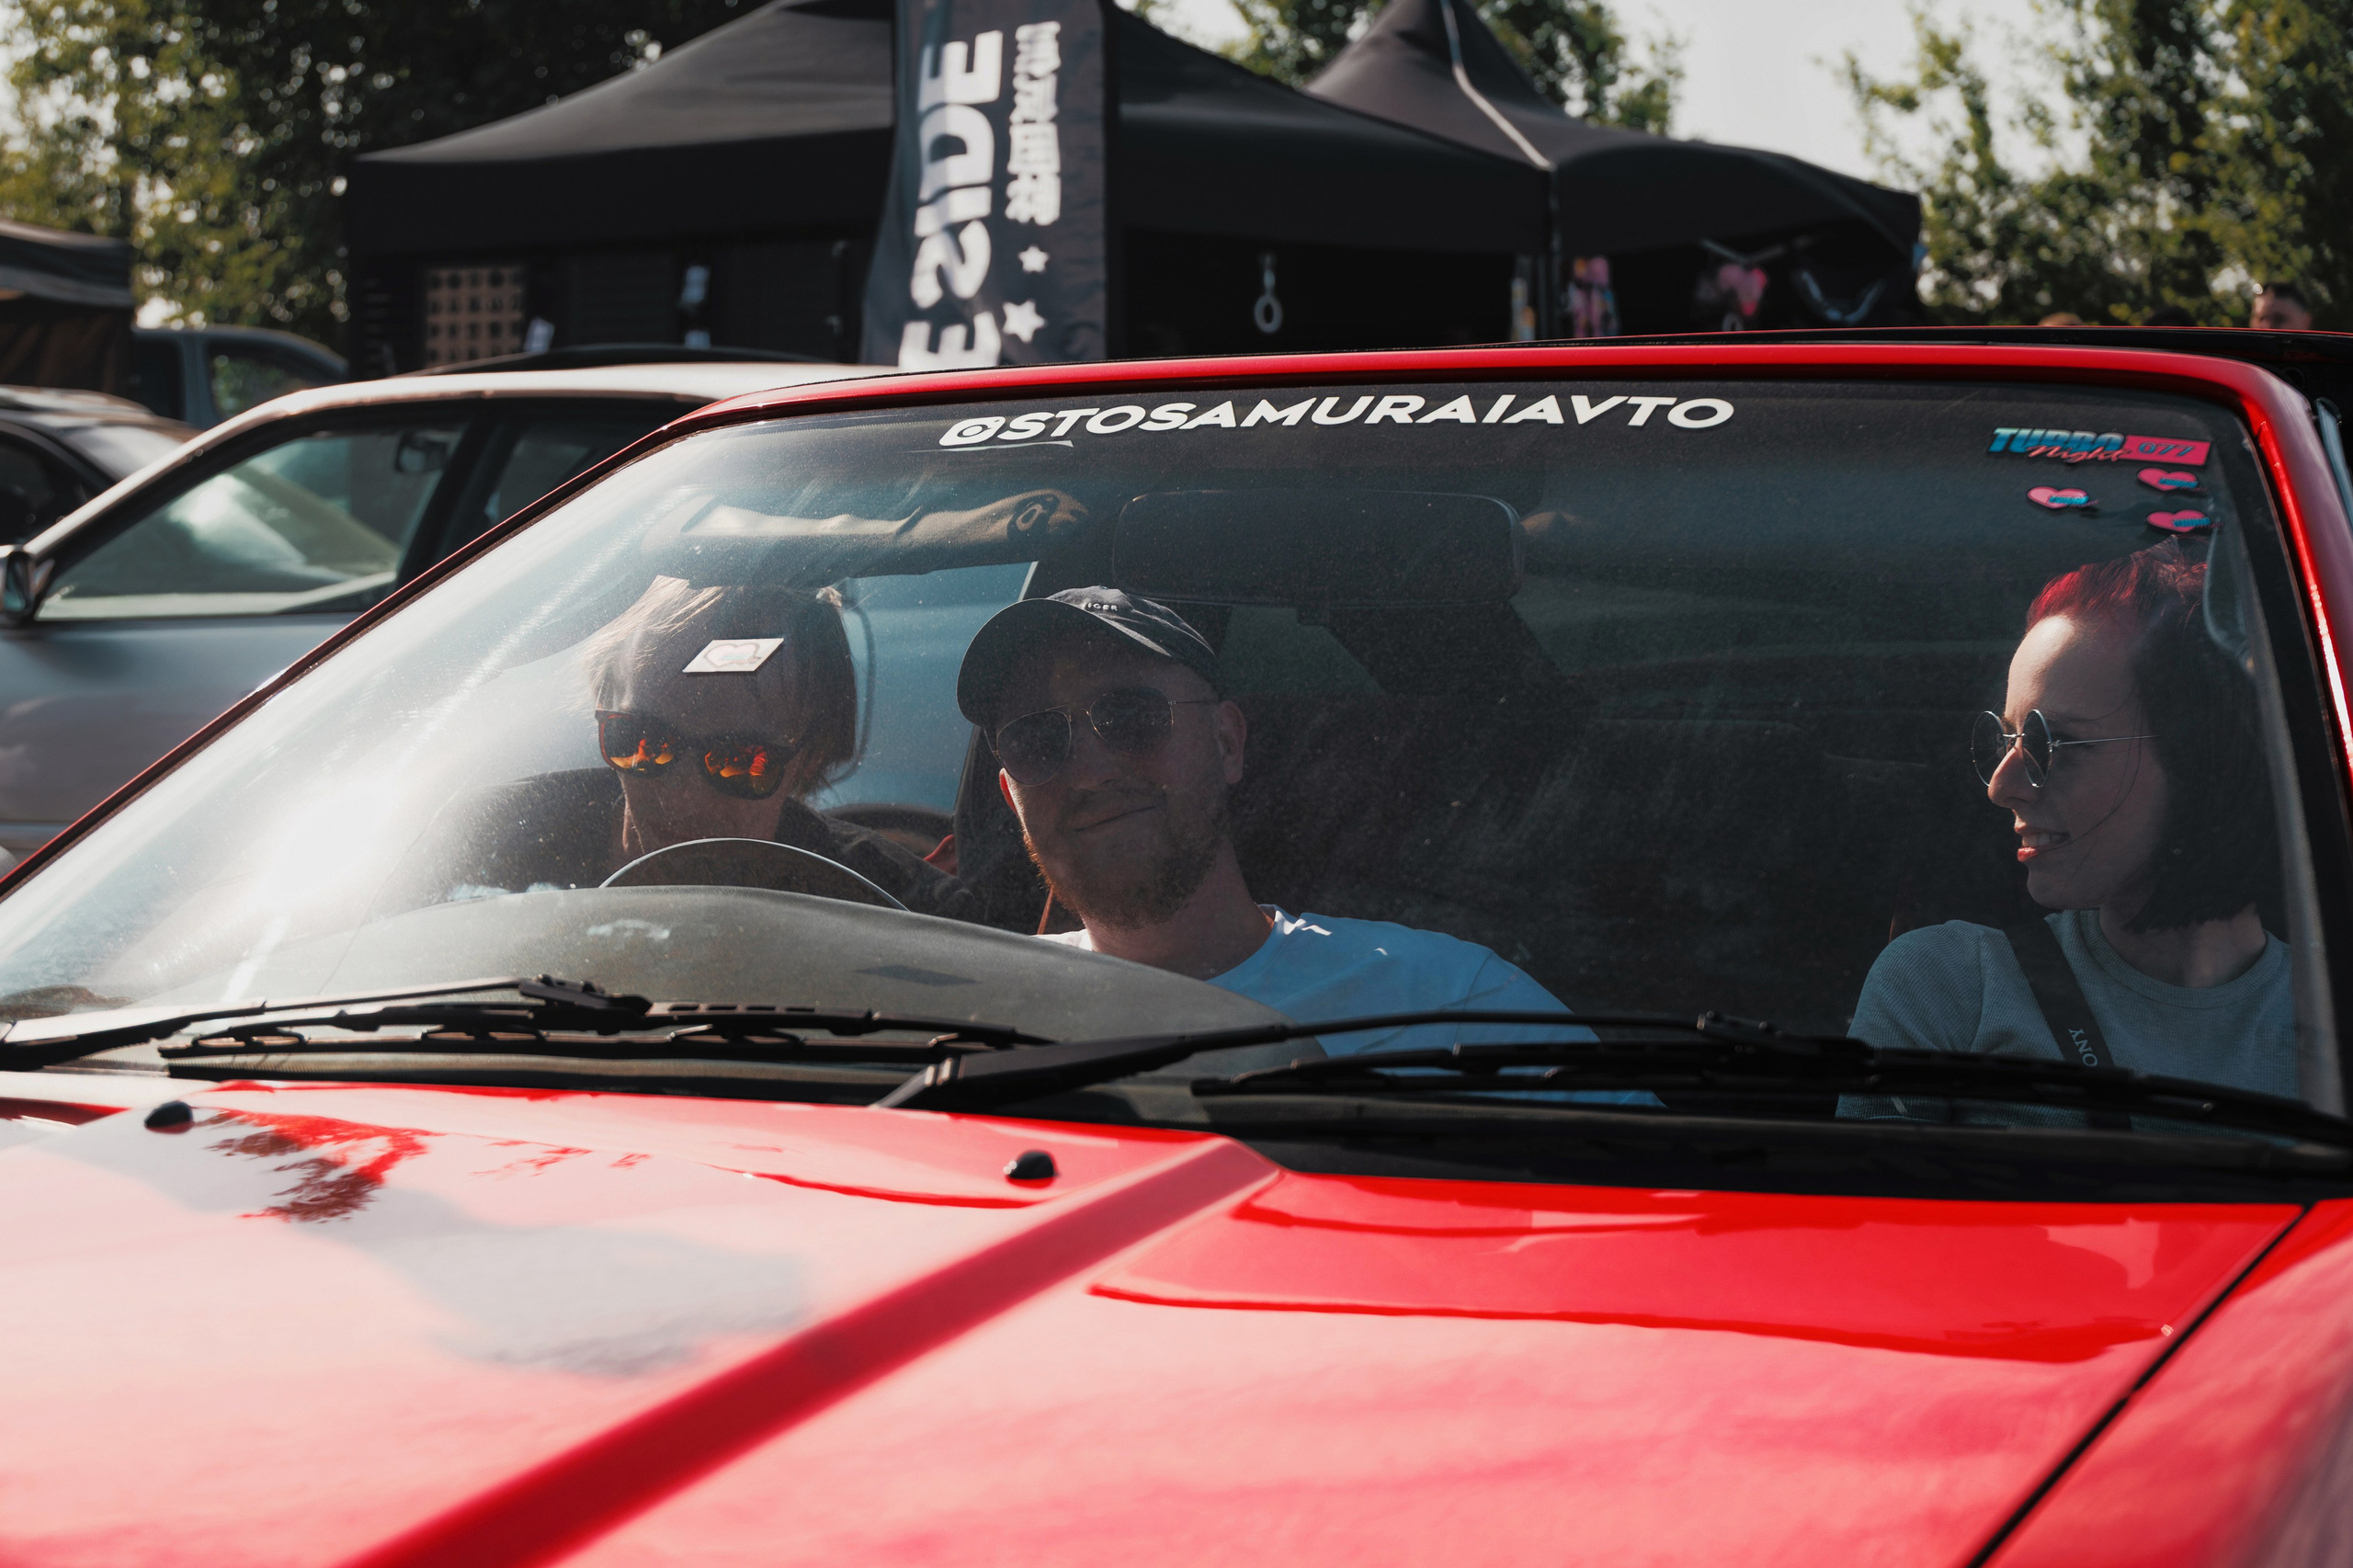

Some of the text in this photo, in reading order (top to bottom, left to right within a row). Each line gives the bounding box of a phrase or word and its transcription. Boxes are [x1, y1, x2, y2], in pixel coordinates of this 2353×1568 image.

[2026, 443, 2132, 463] Night
[2138, 441, 2196, 457] 077
[2068, 1028, 2098, 1067] ONY
